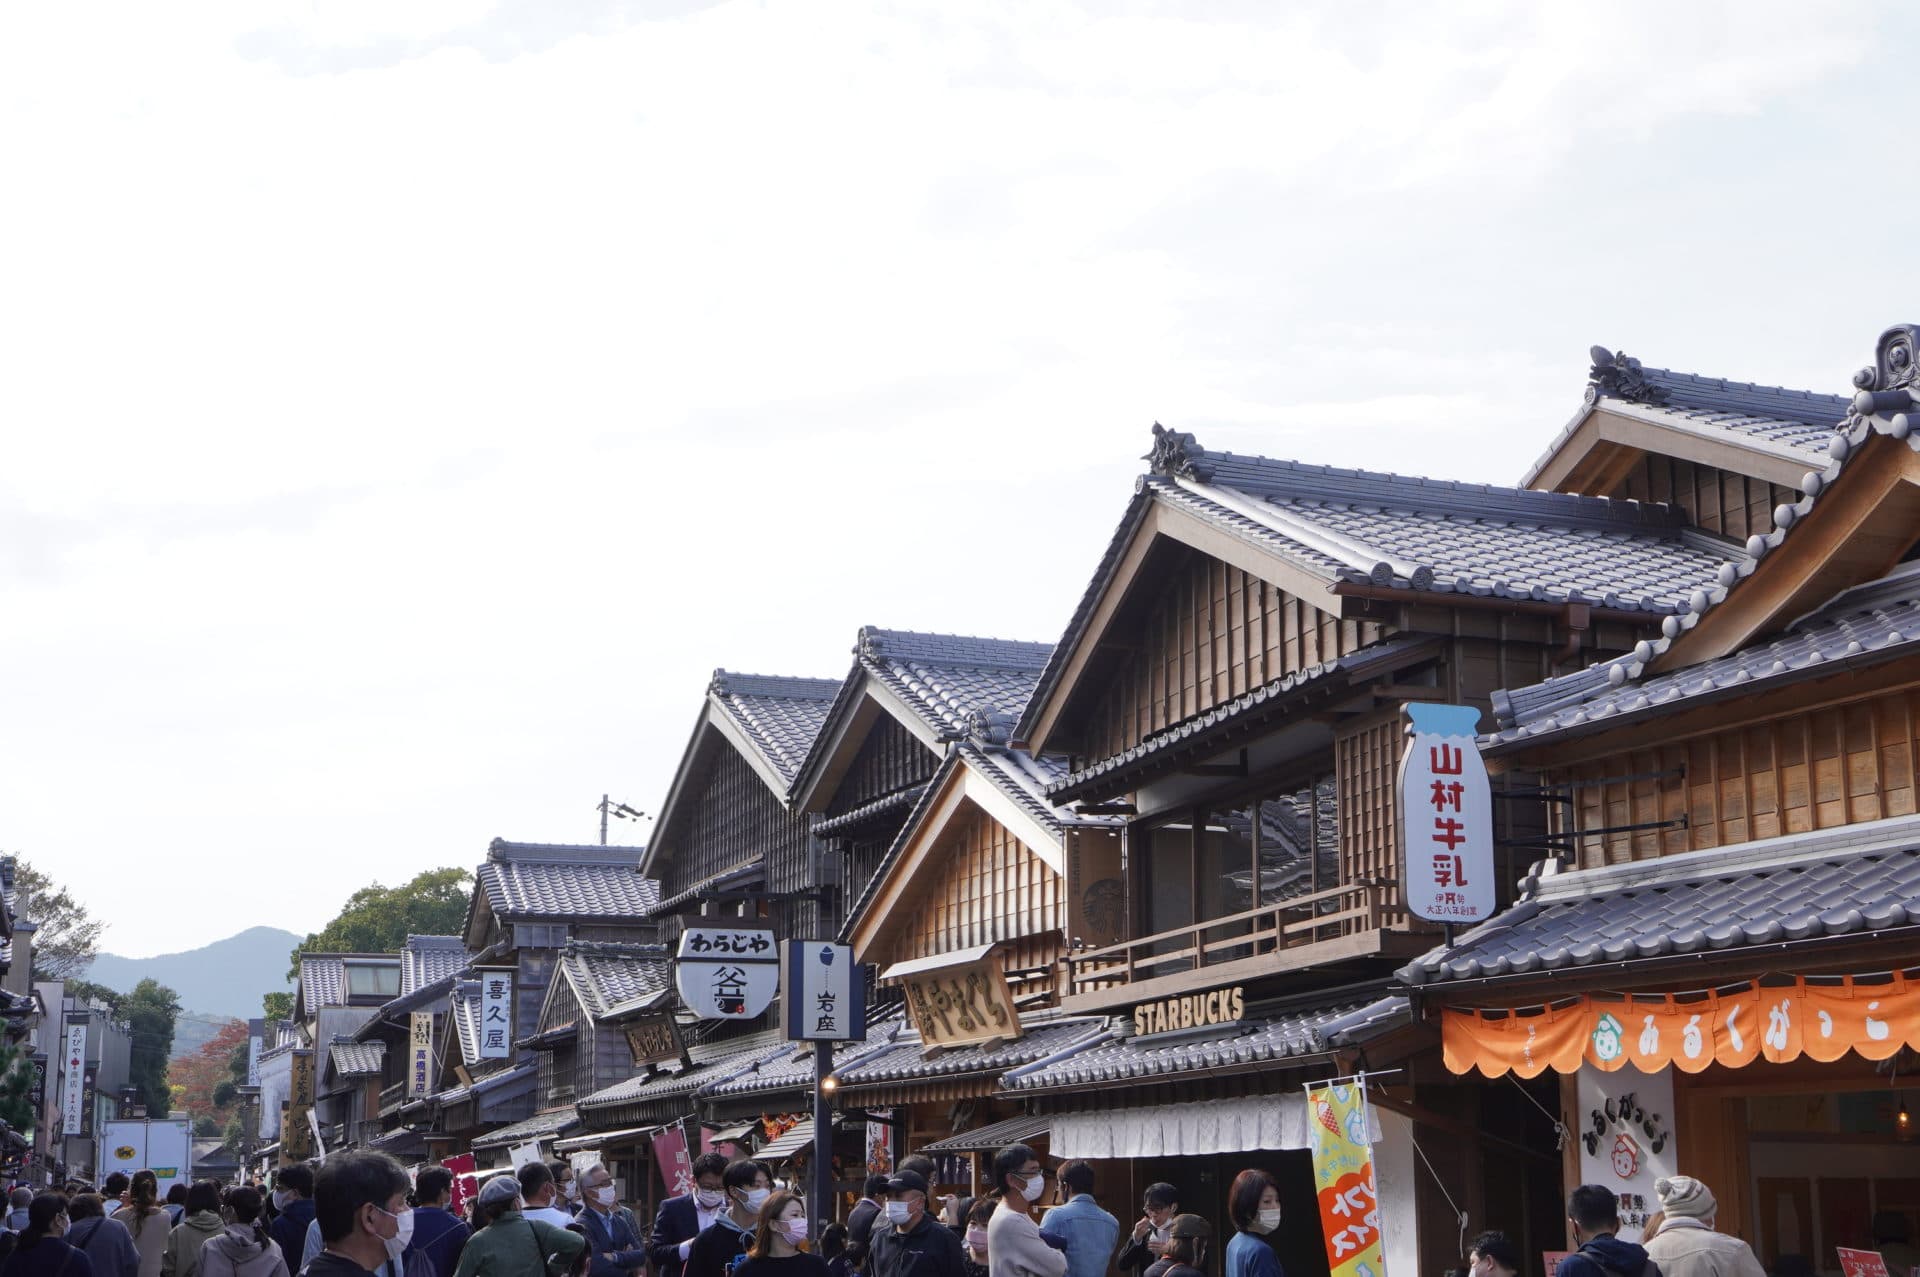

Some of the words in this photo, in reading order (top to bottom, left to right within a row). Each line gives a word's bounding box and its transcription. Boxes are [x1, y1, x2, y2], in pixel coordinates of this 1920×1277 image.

[1430, 743, 1468, 888] 山村牛乳
[1427, 905, 1477, 916] 大正八年創業
[690, 933, 769, 953] わらじや
[483, 980, 507, 1049] 喜久屋
[816, 990, 837, 1032] 岩座
[1135, 987, 1244, 1036] STARBUCKS
[416, 1049, 426, 1093] 高橋酒店
